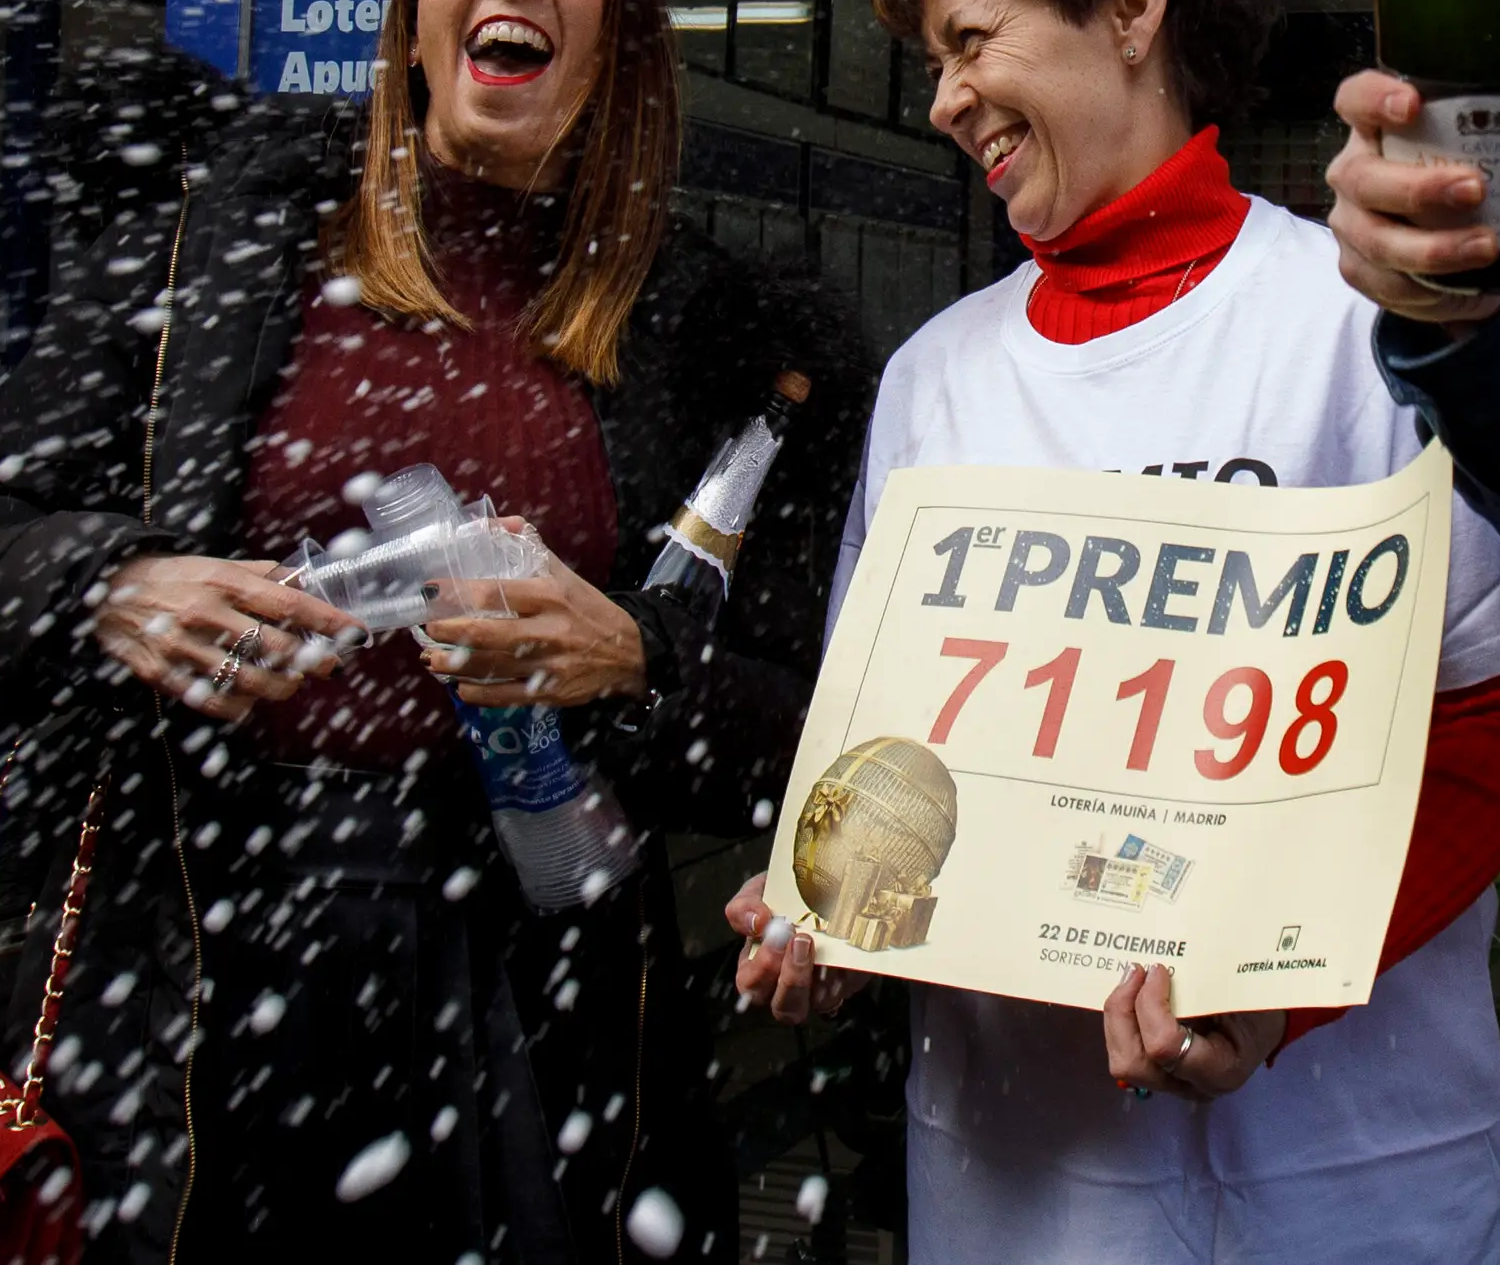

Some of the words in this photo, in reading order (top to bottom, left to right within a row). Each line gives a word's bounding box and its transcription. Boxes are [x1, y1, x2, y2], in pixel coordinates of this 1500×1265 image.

[993, 530, 1411, 638] PREMIO
[926, 637, 1350, 781] 71198
[527, 728, 560, 754] 200
[1050, 795, 1106, 814] LOTERÍA
[1110, 803, 1157, 821] MUIÑA
[1173, 811, 1228, 826] MADRID
[1038, 923, 1062, 942] 22
[1065, 927, 1090, 945] DE
[1093, 930, 1187, 957] DICIEMBRE
[1040, 948, 1093, 968] SORTEO
[1096, 956, 1114, 971] DE
[1237, 957, 1275, 974] LOTERÍA
[1276, 957, 1328, 971] NACIONAL
